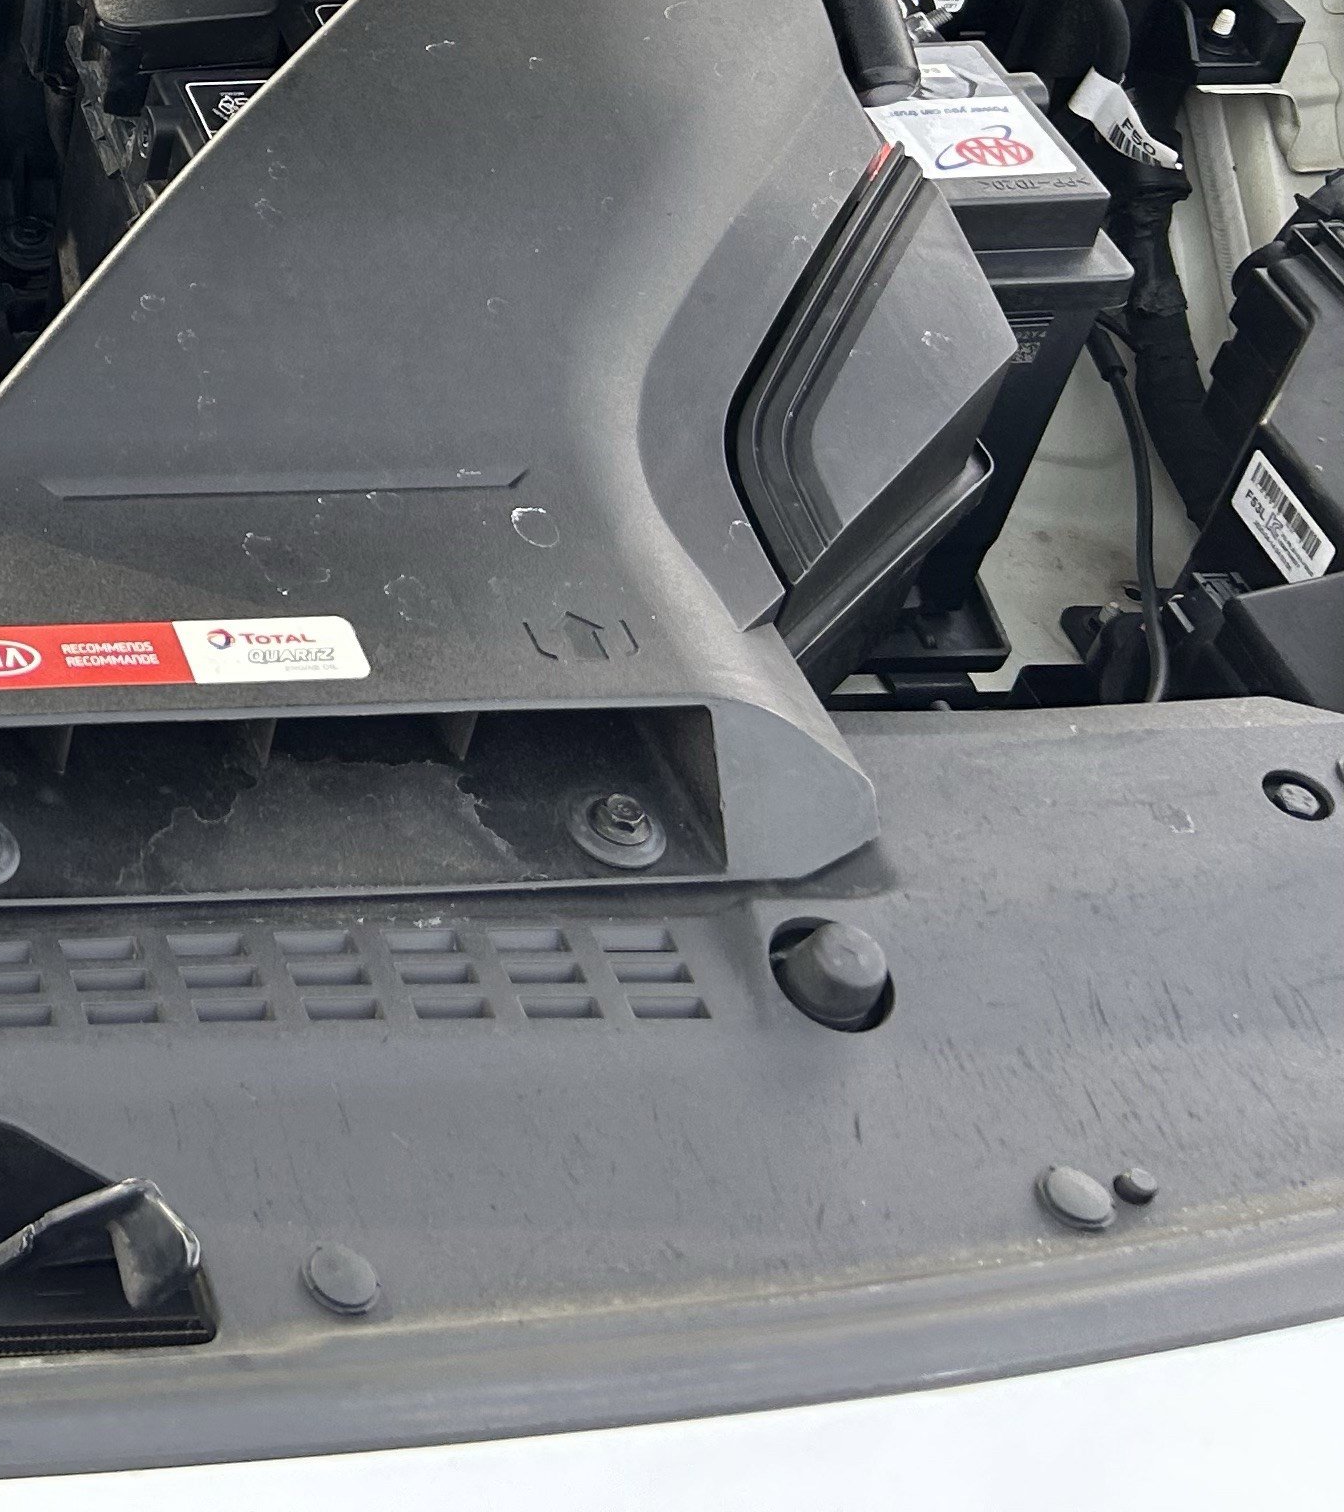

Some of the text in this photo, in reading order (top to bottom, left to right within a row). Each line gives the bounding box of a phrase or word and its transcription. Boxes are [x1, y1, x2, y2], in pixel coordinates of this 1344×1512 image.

[1121, 117, 1156, 156] F50
[1244, 488, 1265, 522] F53L
[238, 631, 316, 646] TOTAL
[60, 640, 154, 655] RECOMMENDS
[248, 646, 336, 665] QUARTZ
[65, 653, 161, 668] RECOMMANDE
